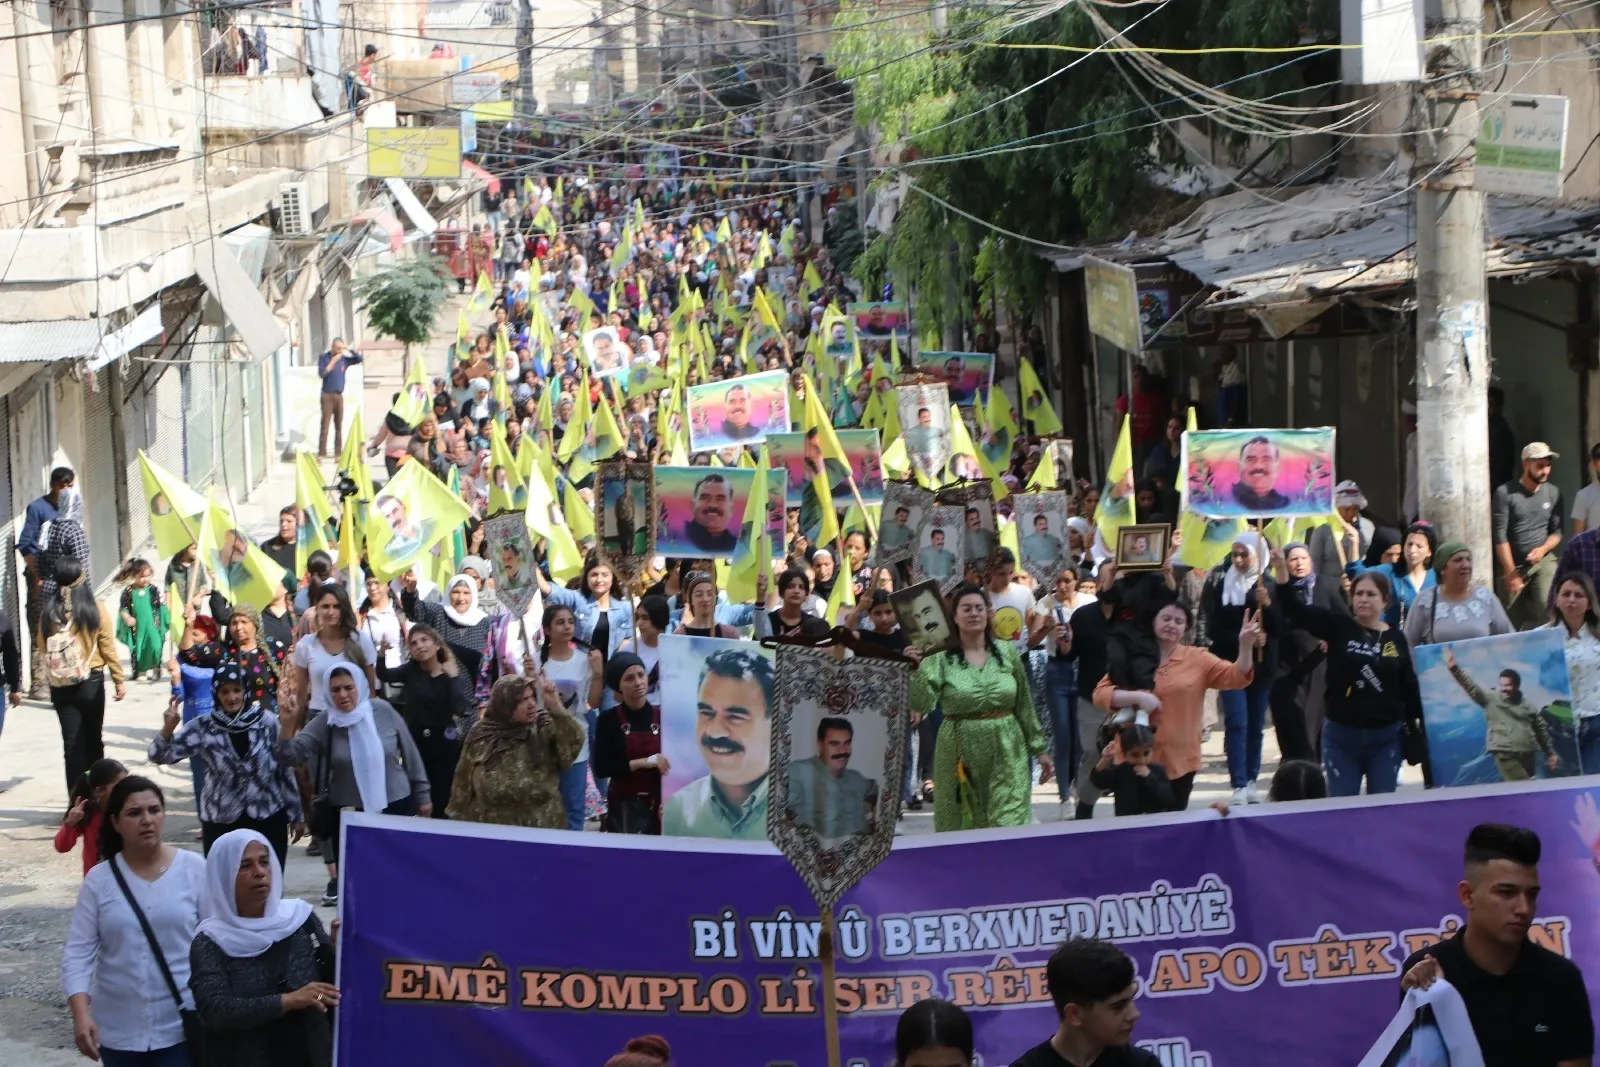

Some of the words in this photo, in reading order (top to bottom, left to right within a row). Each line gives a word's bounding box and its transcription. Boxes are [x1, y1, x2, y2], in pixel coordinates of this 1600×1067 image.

[749, 910, 822, 958] VÎN
[838, 909, 867, 958] Û
[881, 877, 1231, 957] BERXWEDANİYÊ
[385, 956, 507, 1005] EMÊ
[521, 971, 748, 1014] KOMPLO
[833, 974, 935, 1013] SER
[1149, 947, 1263, 993] APO
[1274, 928, 1398, 982] TÊK
